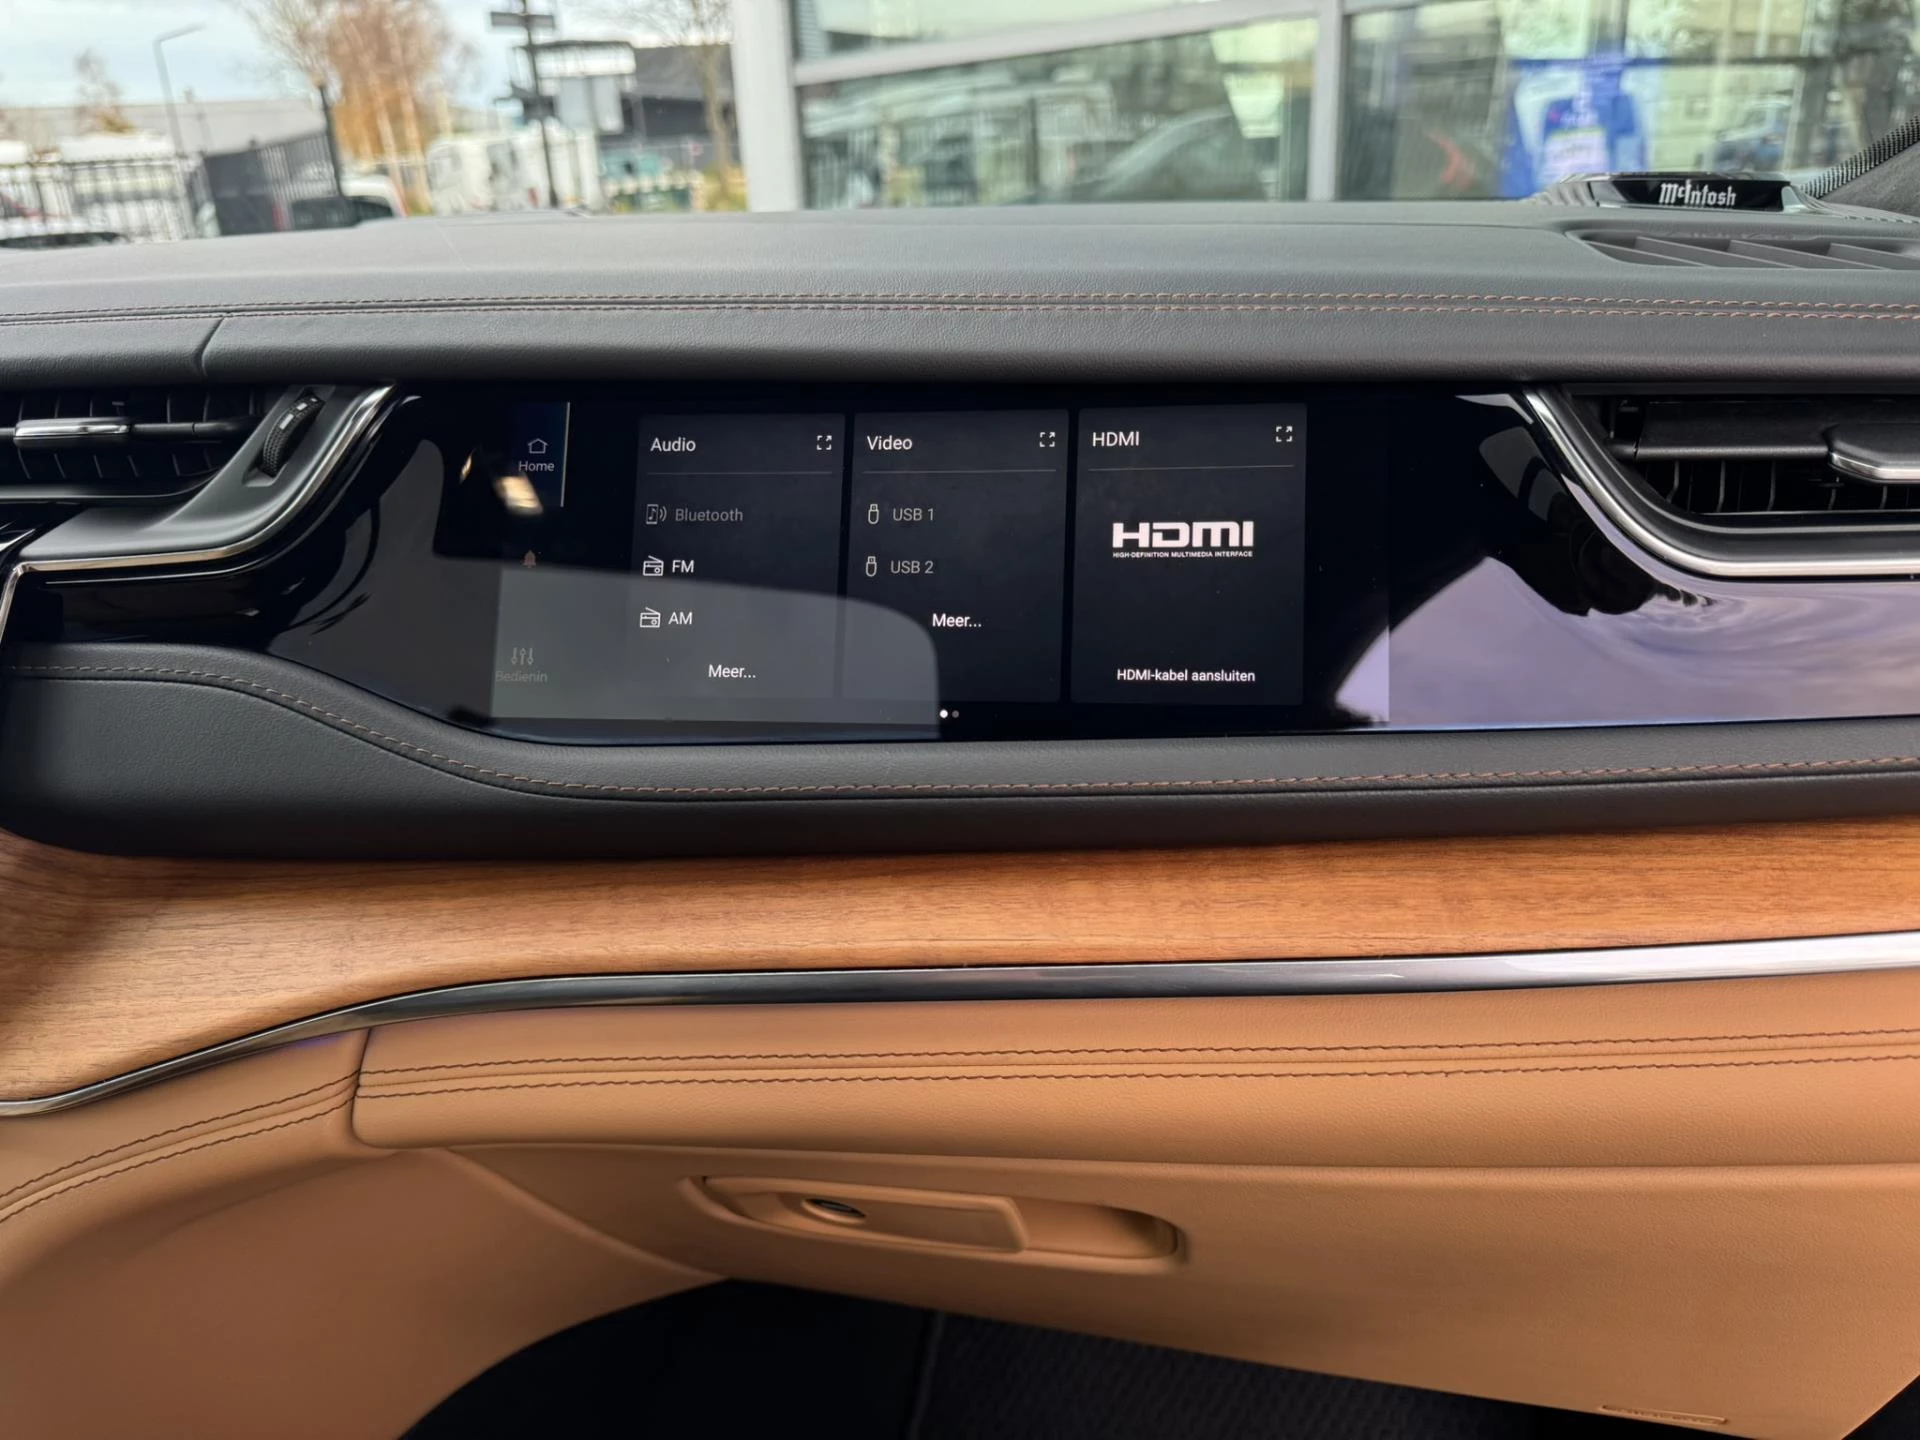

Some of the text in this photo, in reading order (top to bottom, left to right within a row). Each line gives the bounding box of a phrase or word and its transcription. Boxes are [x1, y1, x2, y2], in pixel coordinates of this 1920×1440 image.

[1659, 179, 1737, 206] McIntosh
[650, 436, 697, 453] Audio
[866, 435, 914, 451] Video
[1091, 431, 1141, 448] HDMI
[518, 460, 556, 472] Home
[675, 507, 744, 523] Bluetooth
[892, 507, 936, 522] USB 1
[1112, 521, 1255, 548] HDMI
[1112, 551, 1170, 559] HIGH-DEFINITION
[1214, 550, 1254, 558] INTERFACE
[671, 559, 695, 574] FM
[890, 560, 935, 575] USB 2
[668, 611, 693, 625] AM
[931, 613, 983, 629] Meer...
[708, 664, 757, 679] Meer...
[1116, 668, 1256, 682] HDMI-kabel aansluiten
